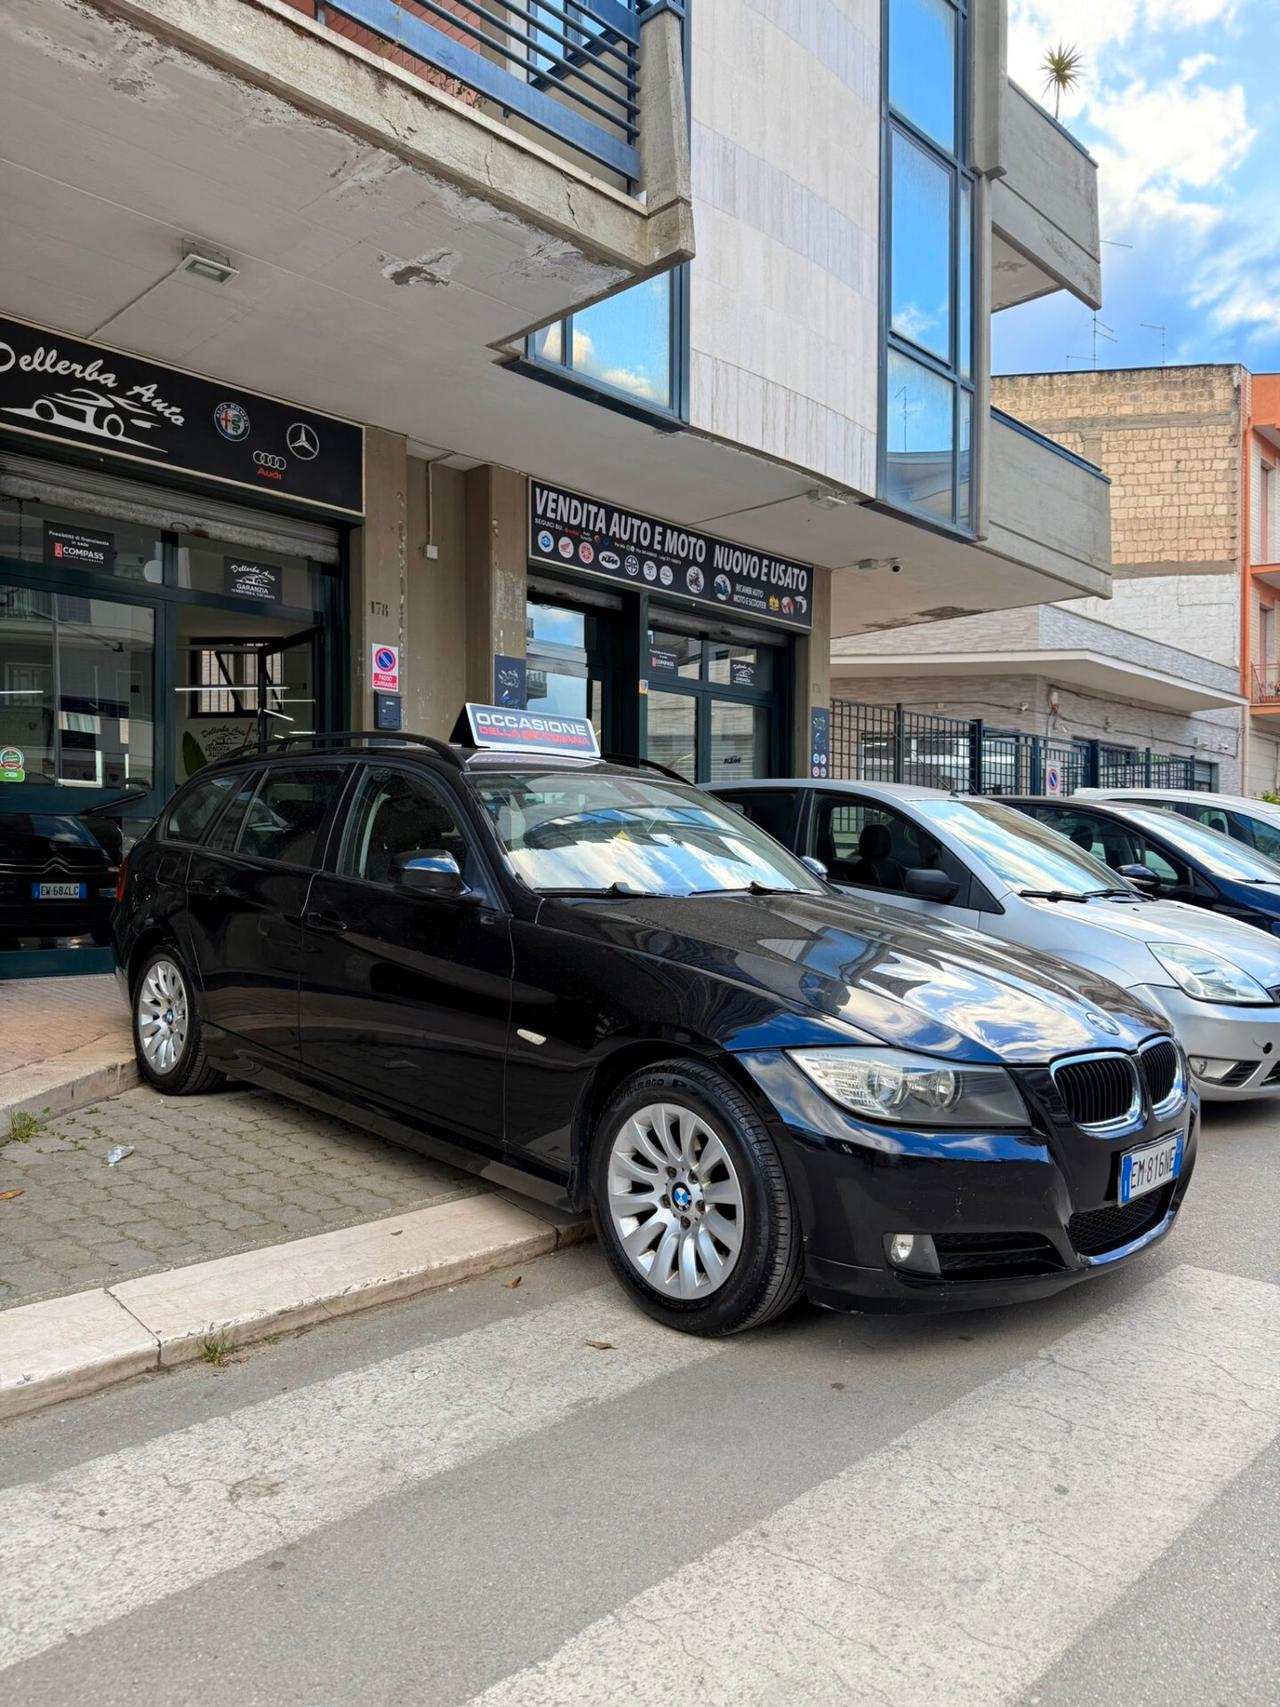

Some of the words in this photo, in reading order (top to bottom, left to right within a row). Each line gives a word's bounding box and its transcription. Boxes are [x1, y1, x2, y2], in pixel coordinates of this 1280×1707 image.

[125, 383, 185, 427] Auto
[257, 467, 282, 480] Audi
[536, 487, 606, 534] VENDITA
[609, 513, 651, 547] AUTO
[653, 525, 663, 550] E
[664, 529, 706, 563] MOTO
[63, 546, 105, 561] COMPASS
[601, 554, 618, 566] KTM
[713, 544, 760, 579] NUOVO
[761, 558, 769, 582] E
[770, 560, 808, 592] USATO
[236, 582, 269, 595] GARANZIA
[370, 600, 389, 617] 178
[475, 712, 588, 737] OCCASIONE
[478, 725, 519, 738] DELLA
